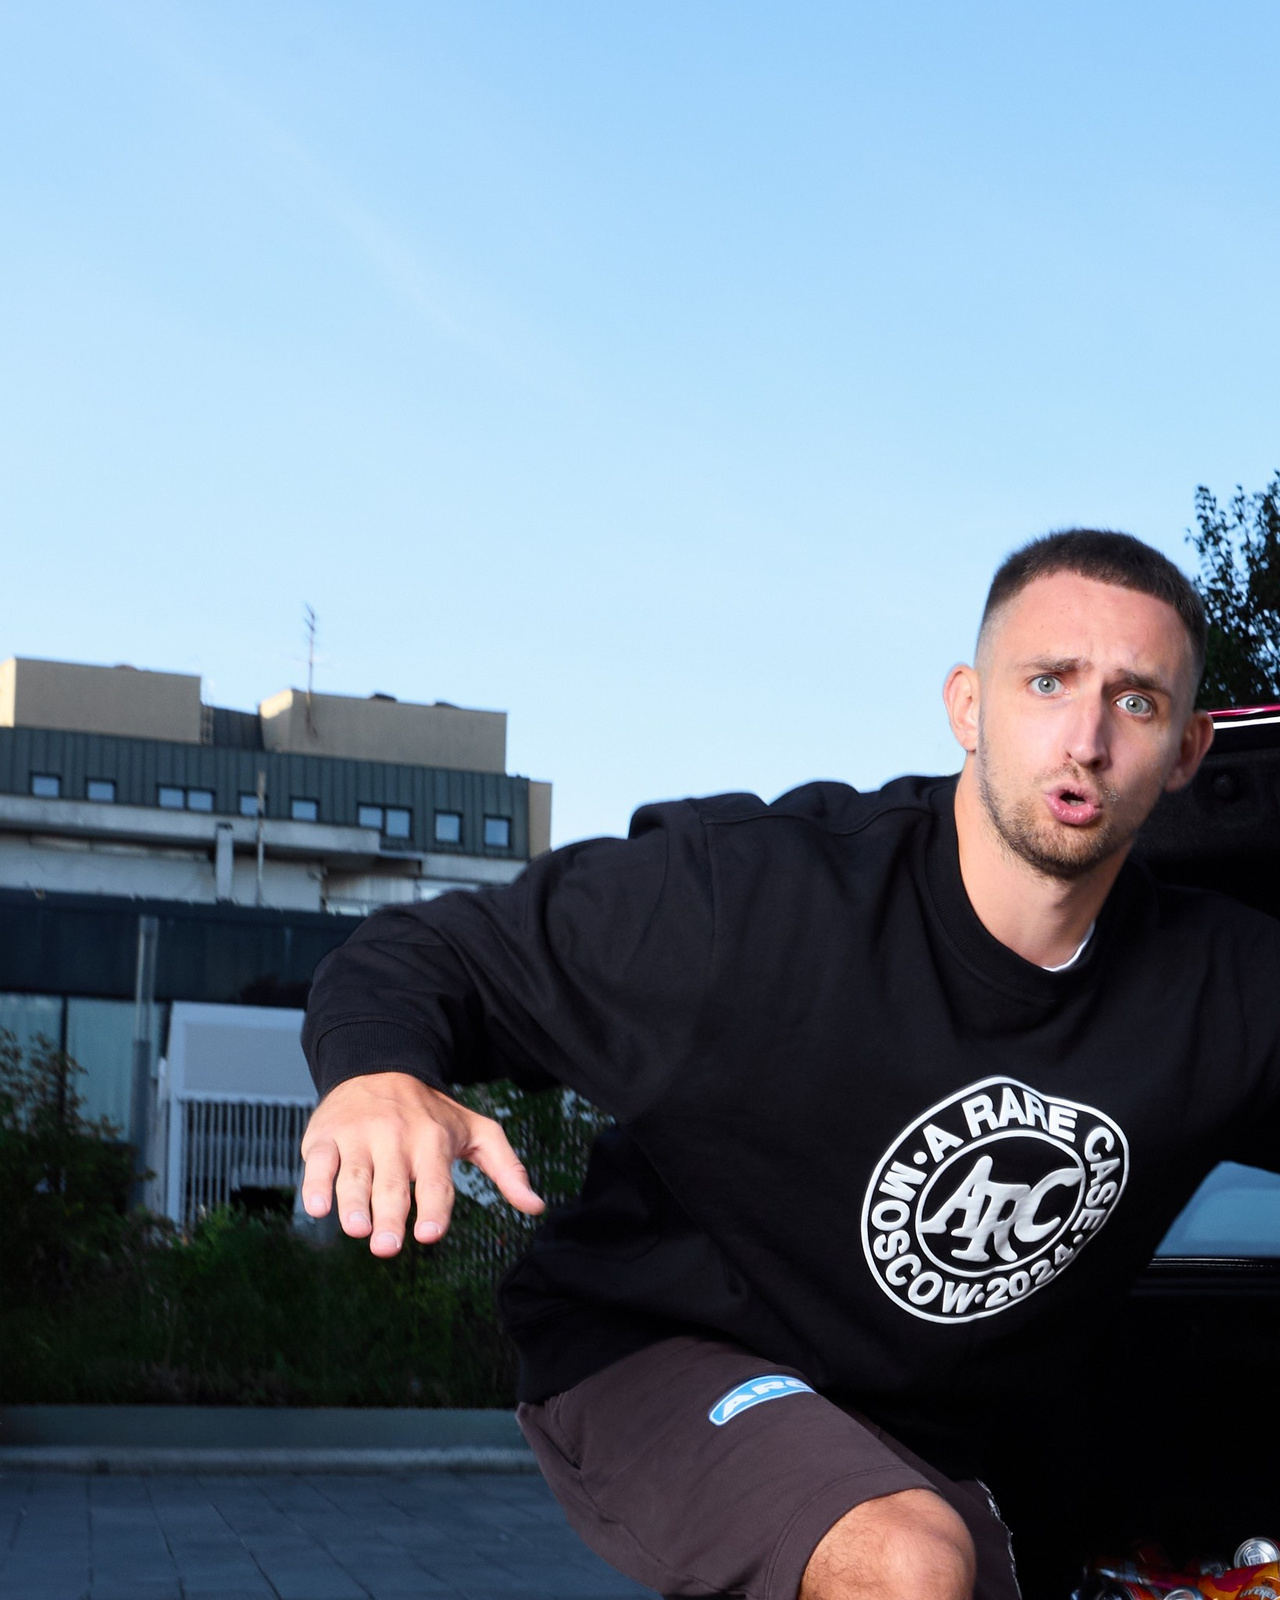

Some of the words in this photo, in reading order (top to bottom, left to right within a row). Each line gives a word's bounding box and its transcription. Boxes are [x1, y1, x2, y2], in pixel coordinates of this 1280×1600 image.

[922, 1123, 964, 1163] A
[961, 1086, 1078, 1143] RARE
[1071, 1126, 1121, 1232] CASE
[985, 1244, 1073, 1308] 2024
